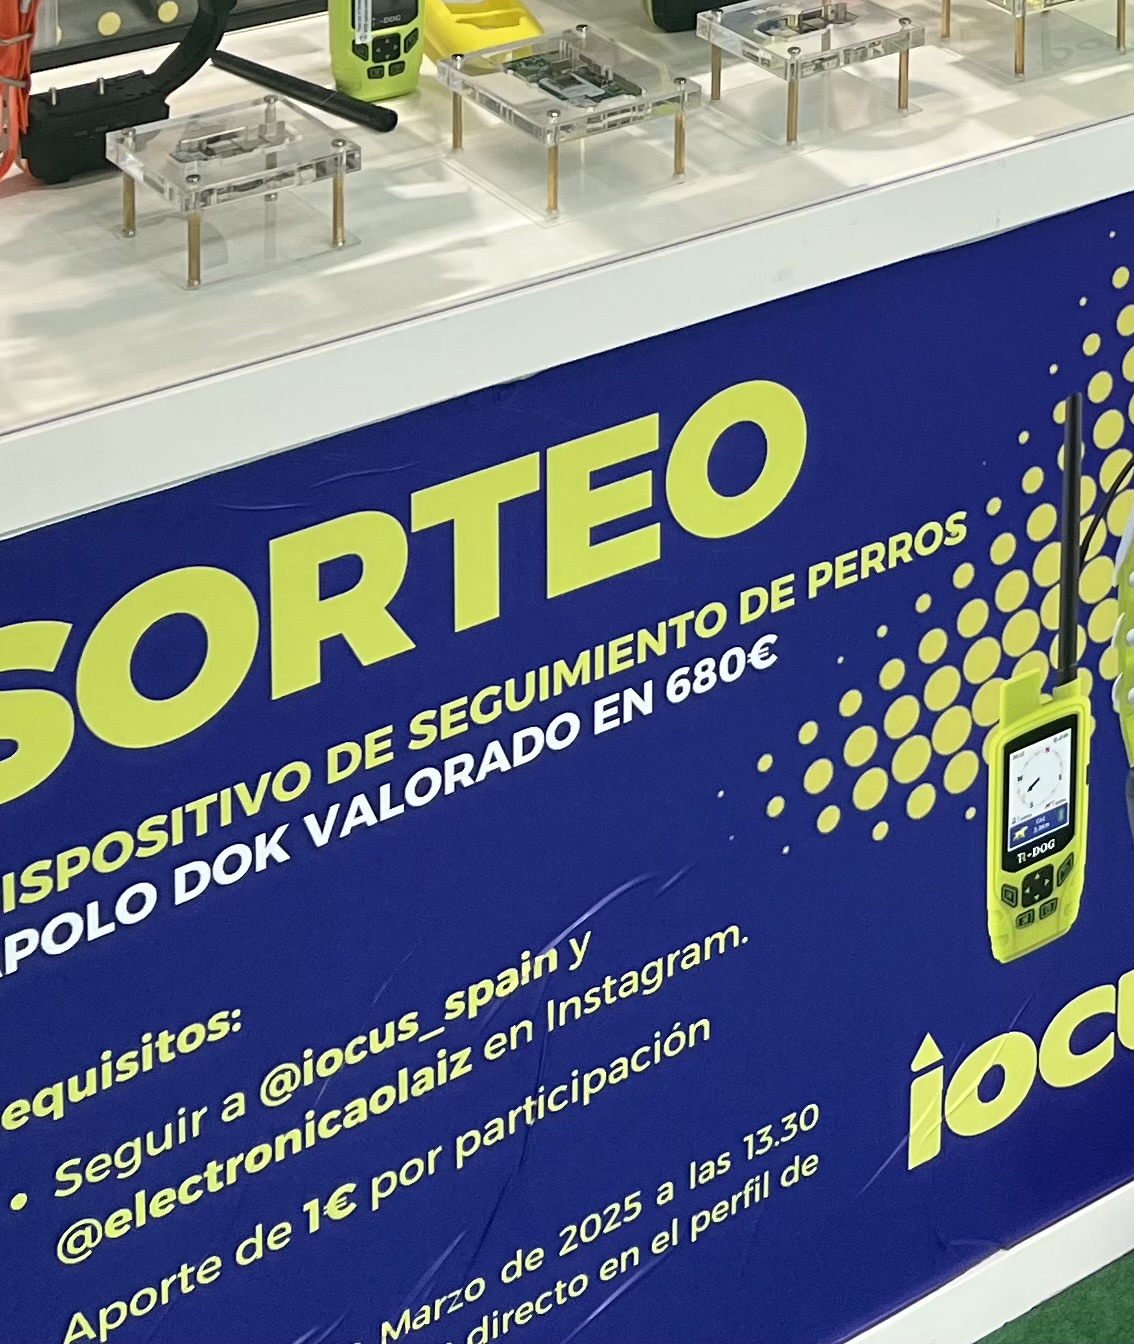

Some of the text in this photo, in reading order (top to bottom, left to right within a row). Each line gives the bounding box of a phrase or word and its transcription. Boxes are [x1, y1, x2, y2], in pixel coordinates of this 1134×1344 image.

[0, 379, 808, 804] SORTEO
[326, 724, 395, 786] DE
[407, 601, 728, 751] SEGUIMIENTO
[739, 573, 796, 626] DE
[807, 510, 968, 600] PERROS
[0, 633, 779, 978] POLO DOK VALORADO EN 680€
[54, 929, 592, 1198] Seguir a @iocus_spain y
[56, 922, 749, 1265] @electronicaolaiz en Instagram.
[63, 1018, 711, 1344] Aporte de 1€ por participación
[380, 1103, 820, 1344] Marzo de 2025 a las 13.30
[466, 1151, 819, 1344] directo en el perfil de
